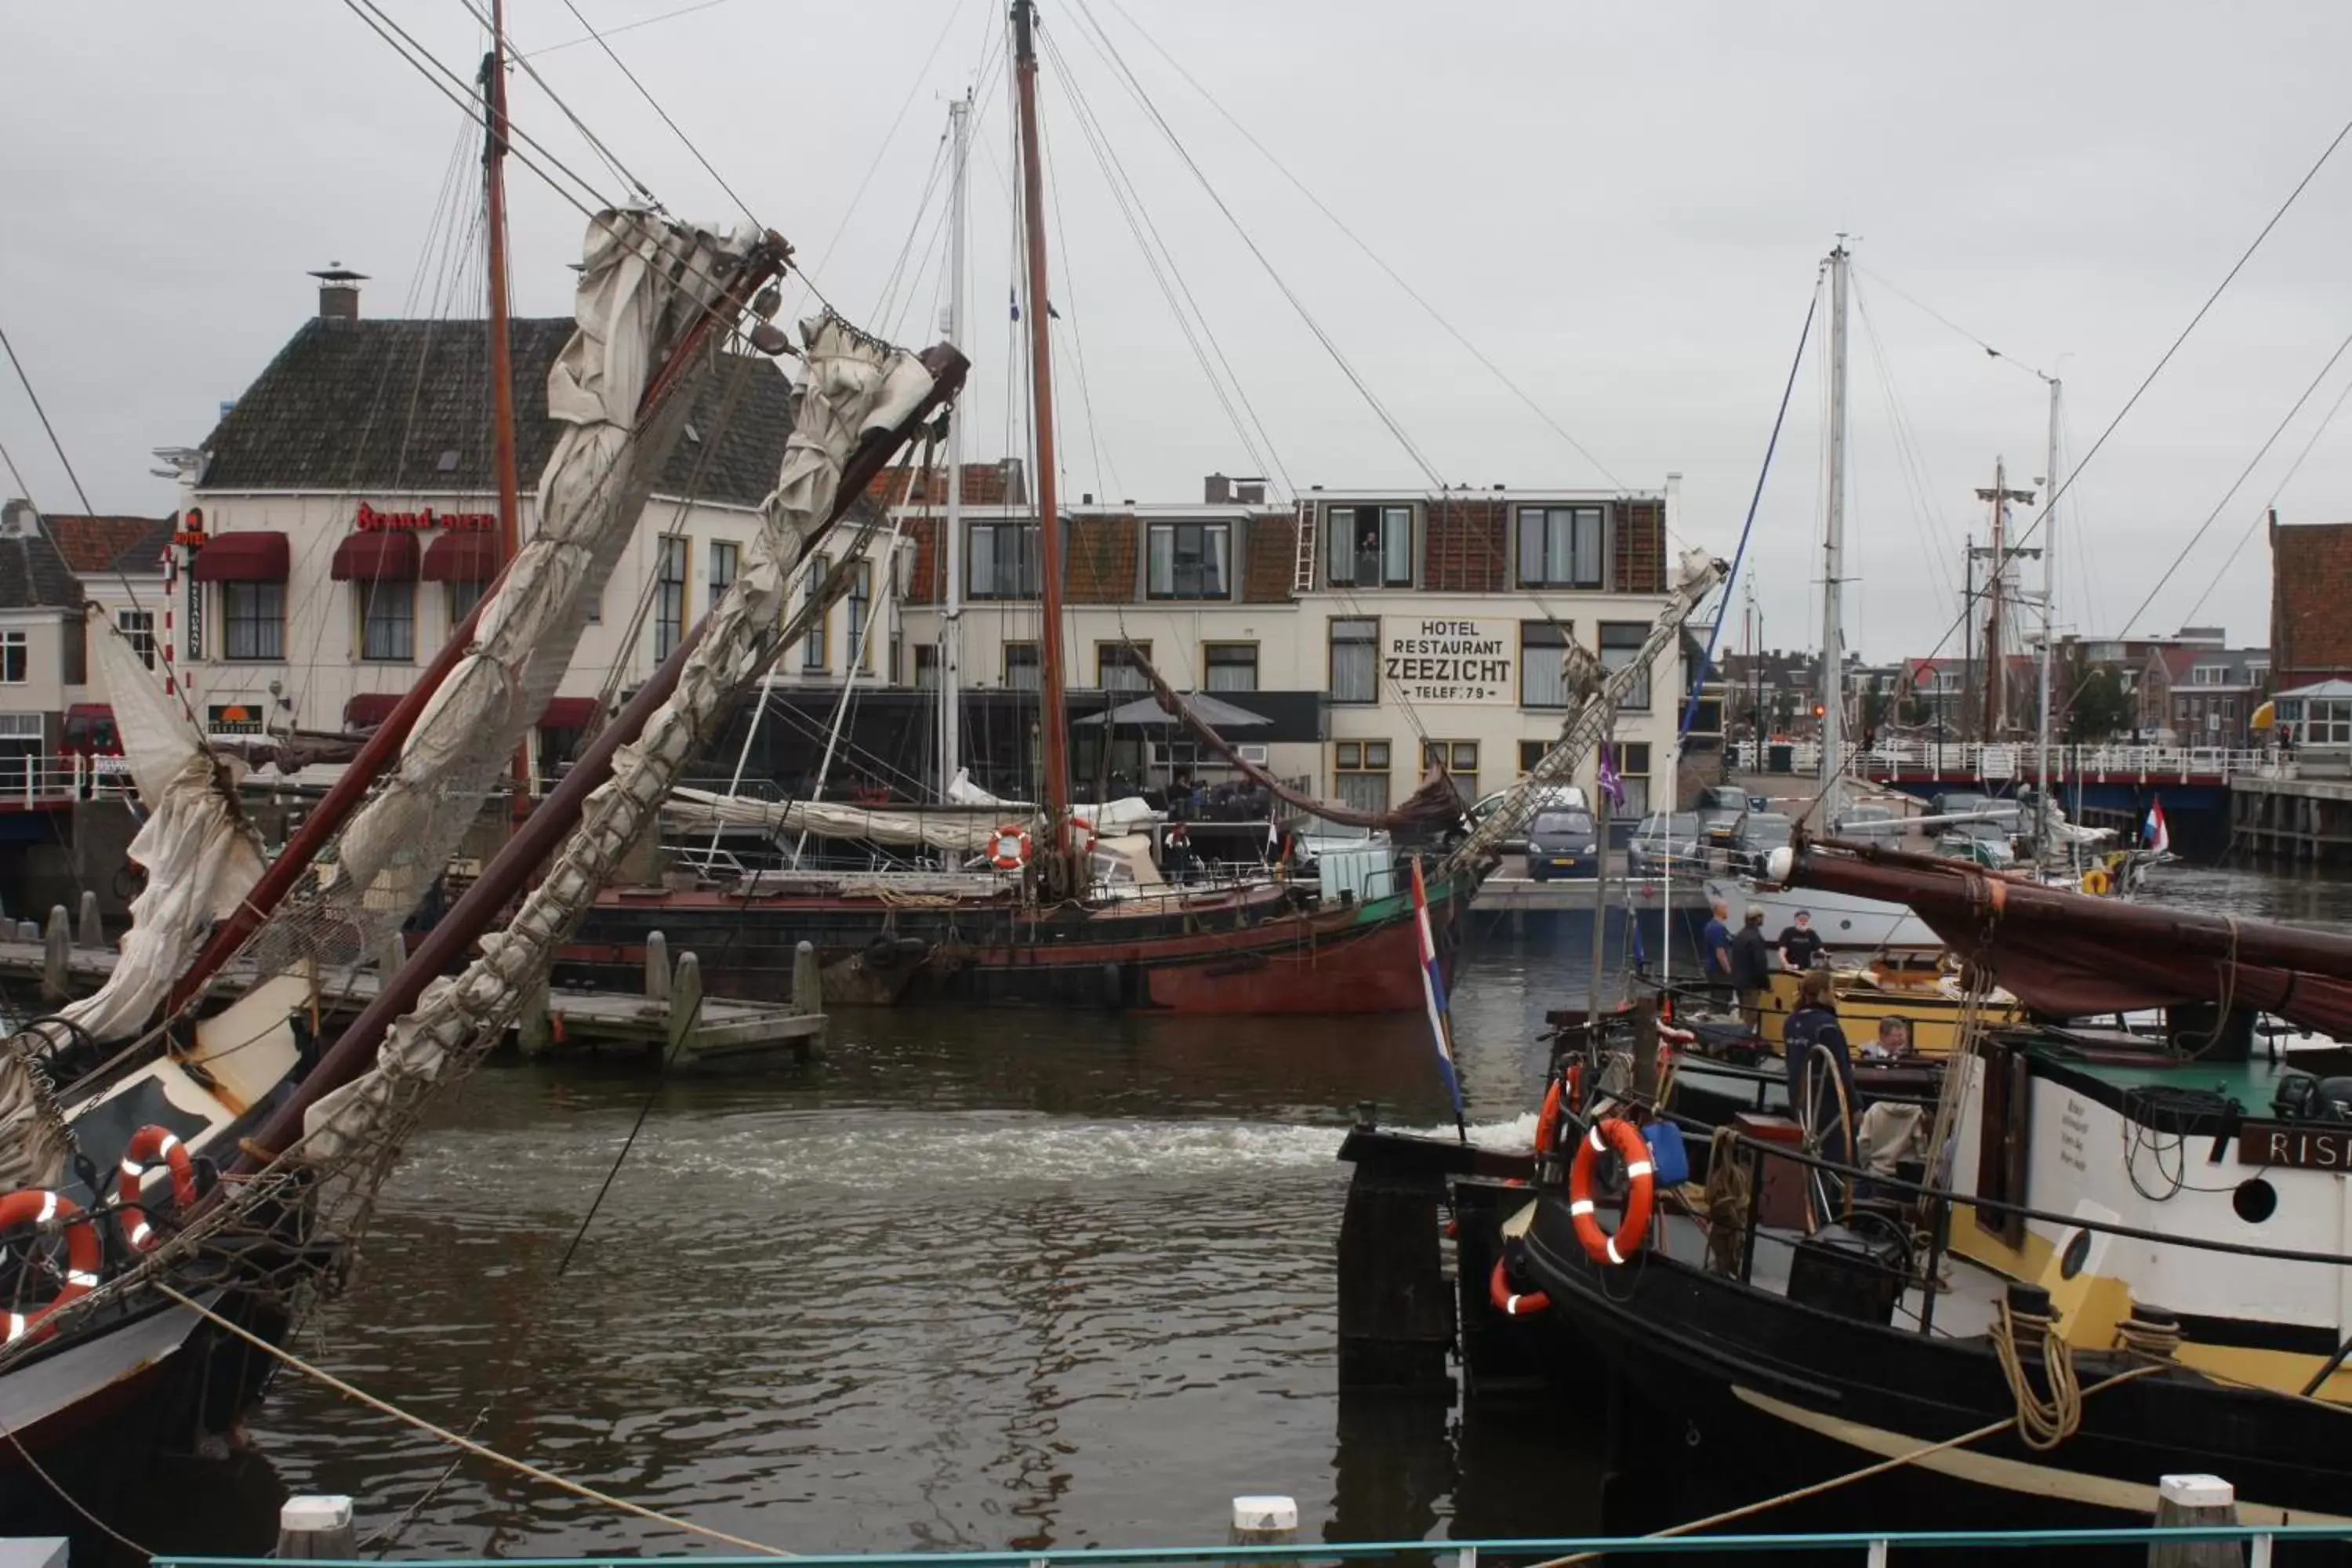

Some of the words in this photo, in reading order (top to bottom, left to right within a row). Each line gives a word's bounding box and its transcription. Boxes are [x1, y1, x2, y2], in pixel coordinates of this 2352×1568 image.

[358, 502, 433, 532] Brand
[1421, 621, 1480, 636] HOTEL
[1393, 640, 1503, 655] RESTAURANT
[1385, 659, 1511, 682] ZEEZICHT
